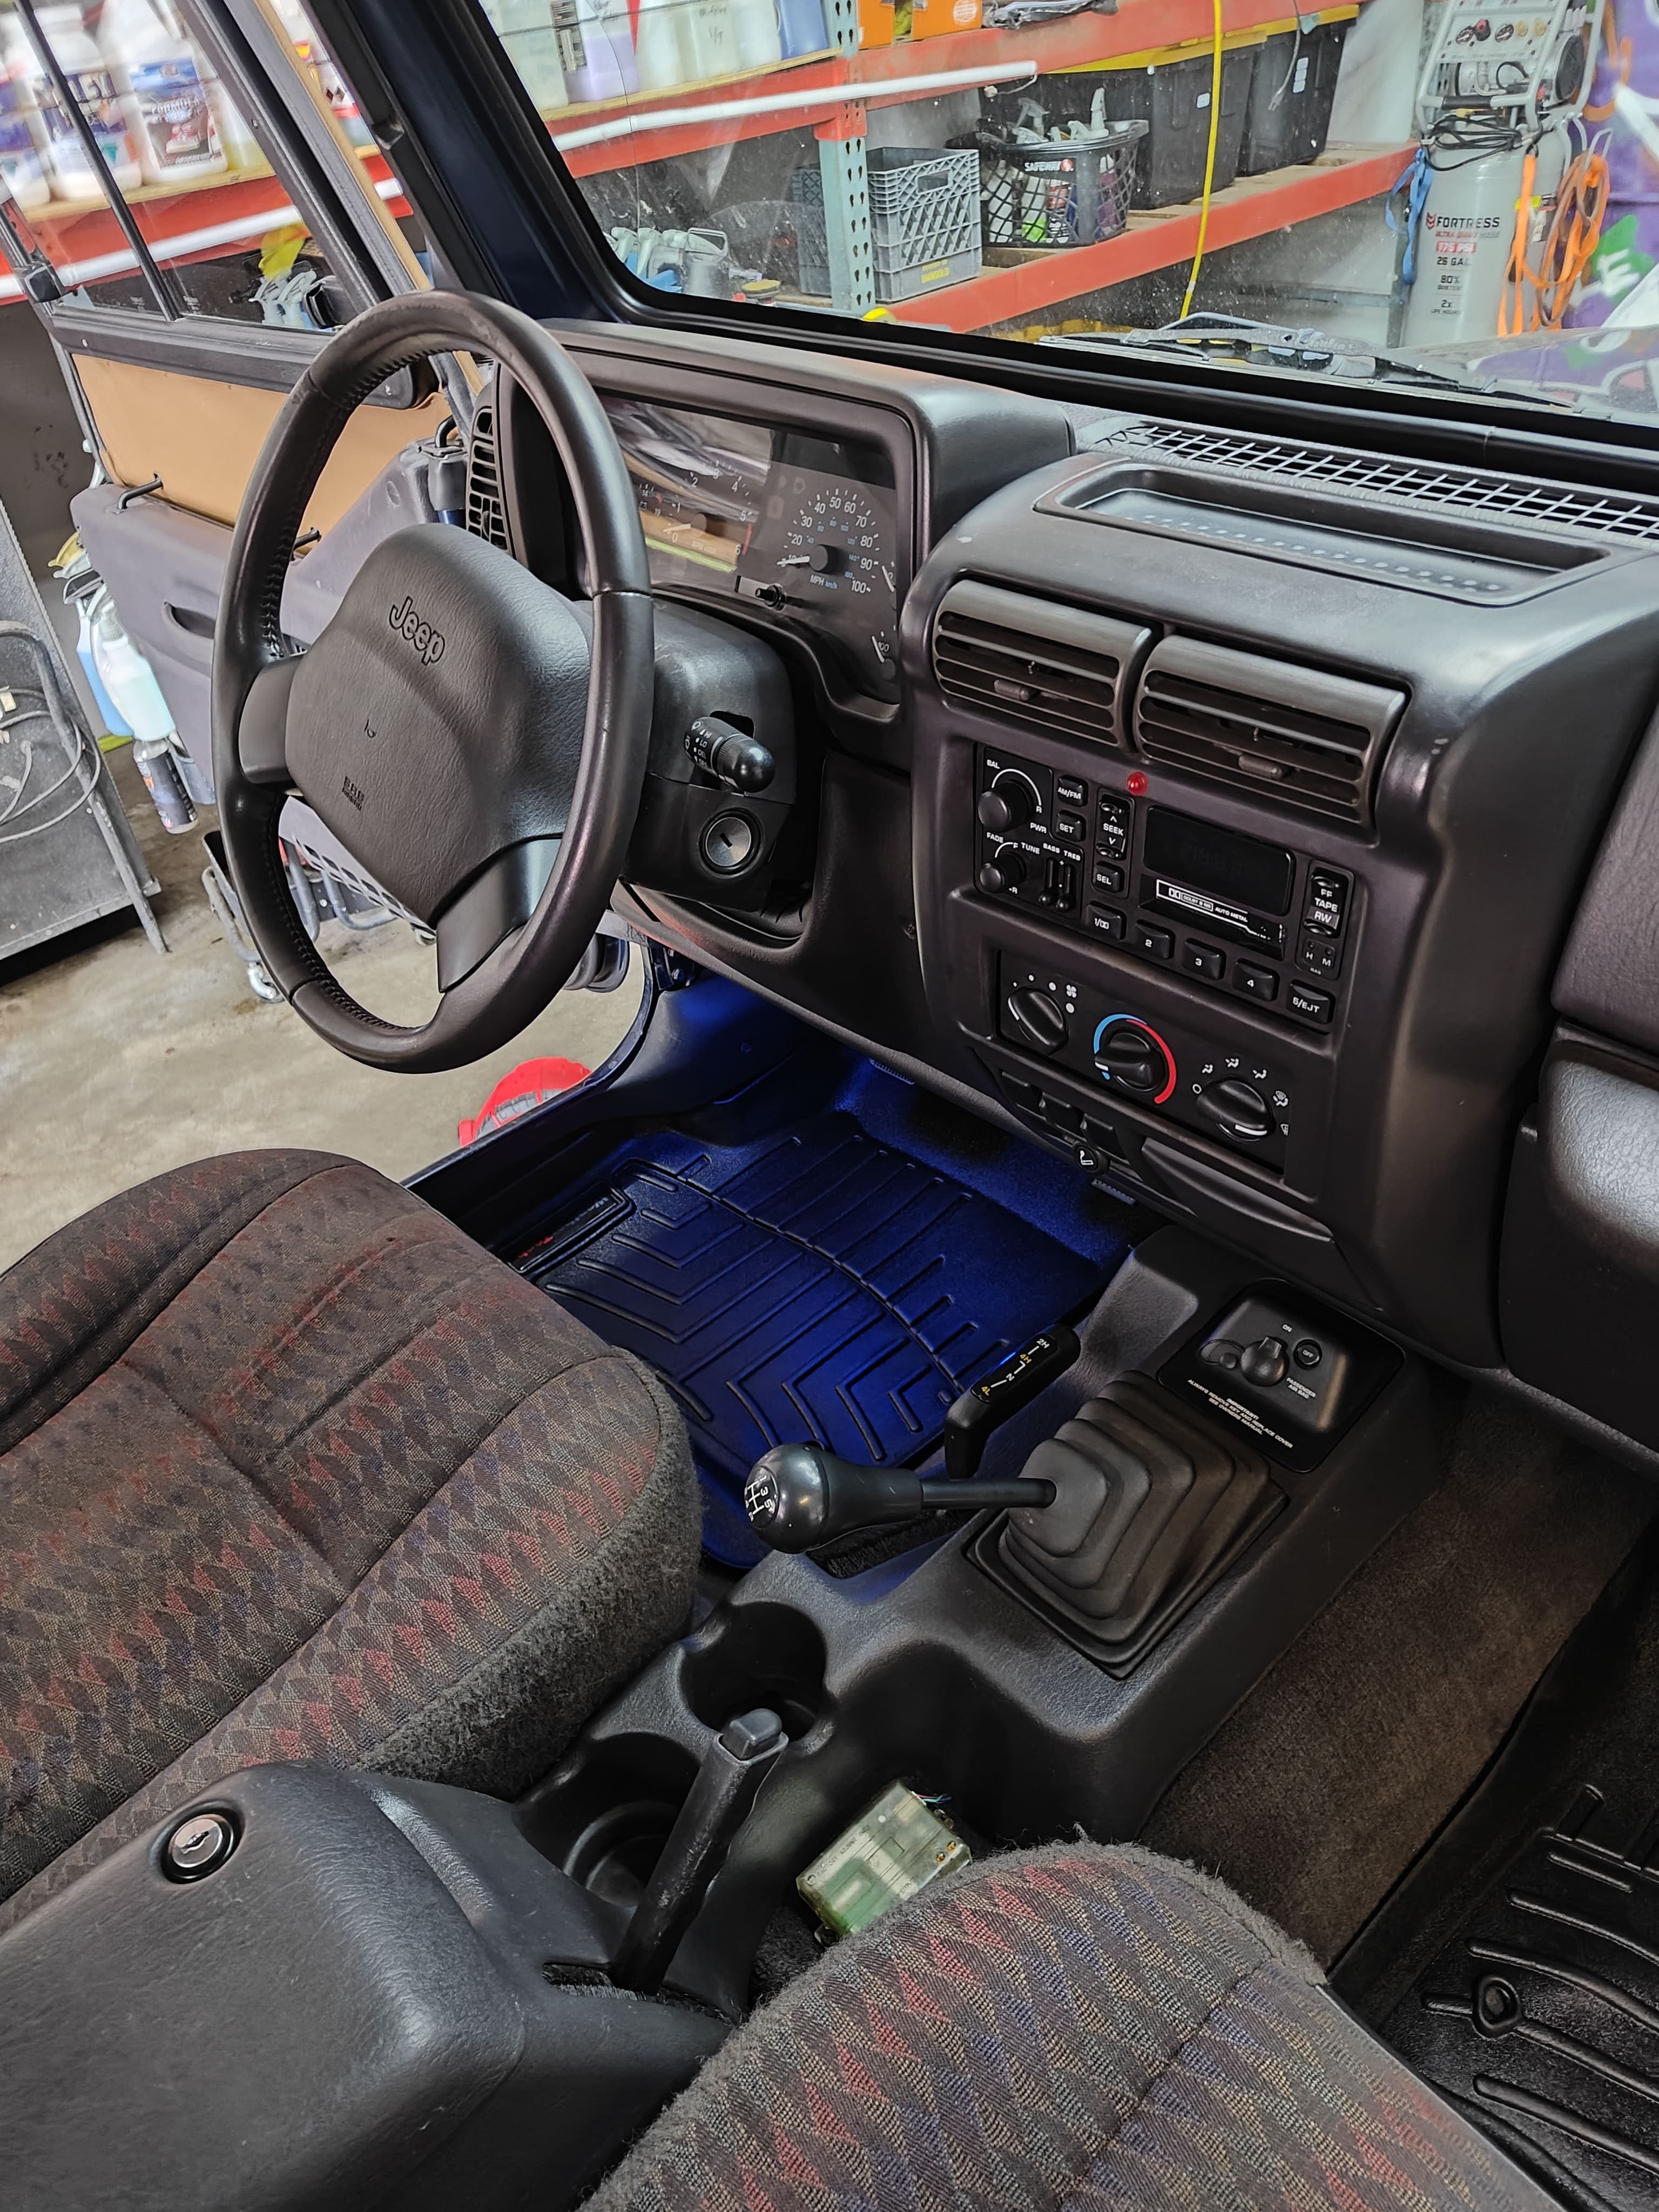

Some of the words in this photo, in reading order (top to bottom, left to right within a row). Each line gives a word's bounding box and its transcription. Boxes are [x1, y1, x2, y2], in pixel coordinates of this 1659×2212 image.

[1437, 216, 1500, 228] FORTRESS
[1437, 256, 1448, 265] 26
[713, 468, 719, 480] 3
[691, 476, 698, 488] 2
[732, 482, 738, 493] 4
[814, 503, 826, 514] 40
[829, 496, 841, 509] 50
[844, 501, 857, 514] 60
[740, 510, 746, 522] 5
[800, 515, 813, 528] 30
[855, 515, 867, 528] 70
[672, 532, 678, 543] 0
[791, 534, 803, 545] 20
[860, 535, 873, 548] 80
[735, 544, 741, 555] 6
[860, 558, 873, 571] 90
[810, 574, 825, 586] MPH
[851, 579, 867, 594] 100
[389, 596, 446, 666] Jeep
[699, 739, 708, 748] LO
[986, 759, 1000, 770] BAL
[1057, 787, 1082, 800] AM/FM
[1036, 805, 1042, 814] R
[1030, 822, 1047, 834] PWR
[1059, 823, 1074, 833] SET
[1103, 822, 1124, 837] SEEK
[986, 832, 1004, 844] FADE
[1020, 841, 1041, 855] TUNE
[1042, 842, 1061, 854] BASS
[1063, 850, 1081, 861] TREB
[1096, 873, 1112, 885] SEL
[1320, 888, 1333, 898] FF
[1314, 897, 1338, 913] TAPE
[1215, 907, 1230, 916] AUTO
[1230, 912, 1249, 922] METAL
[1314, 910, 1332, 923] RW
[1145, 939, 1152, 948] 2
[1195, 957, 1202, 966] 3
[1306, 951, 1313, 960] H
[1321, 957, 1331, 967] M
[1246, 979, 1255, 988] 4
[1292, 996, 1320, 1014] 5/EJT
[1282, 1324, 1292, 1333] ON
[1036, 1338, 1050, 1348] 2H
[1020, 1353, 1032, 1364] 4H
[1006, 1373, 1015, 1381] N
[981, 1386, 991, 1397] 4L
[1286, 1377, 1317, 1398] PASSENGER
[1287, 1384, 1298, 1392] AIR
[1297, 1389, 1310, 1399] BAG
[1187, 1379, 1209, 1394] ALWAYS
[1208, 1392, 1230, 1407] REMOVE
[1229, 1405, 1241, 1414] KEY
[1240, 1412, 1252, 1422] AND
[1252, 1420, 1276, 1437] REPLACE
[1274, 1434, 1293, 1448] COVER
[1208, 1397, 1219, 1406] SEE
[1240, 1418, 1263, 1435] MANUAL
[760, 1486, 768, 1496] 3
[764, 1498, 773, 1508] 5
